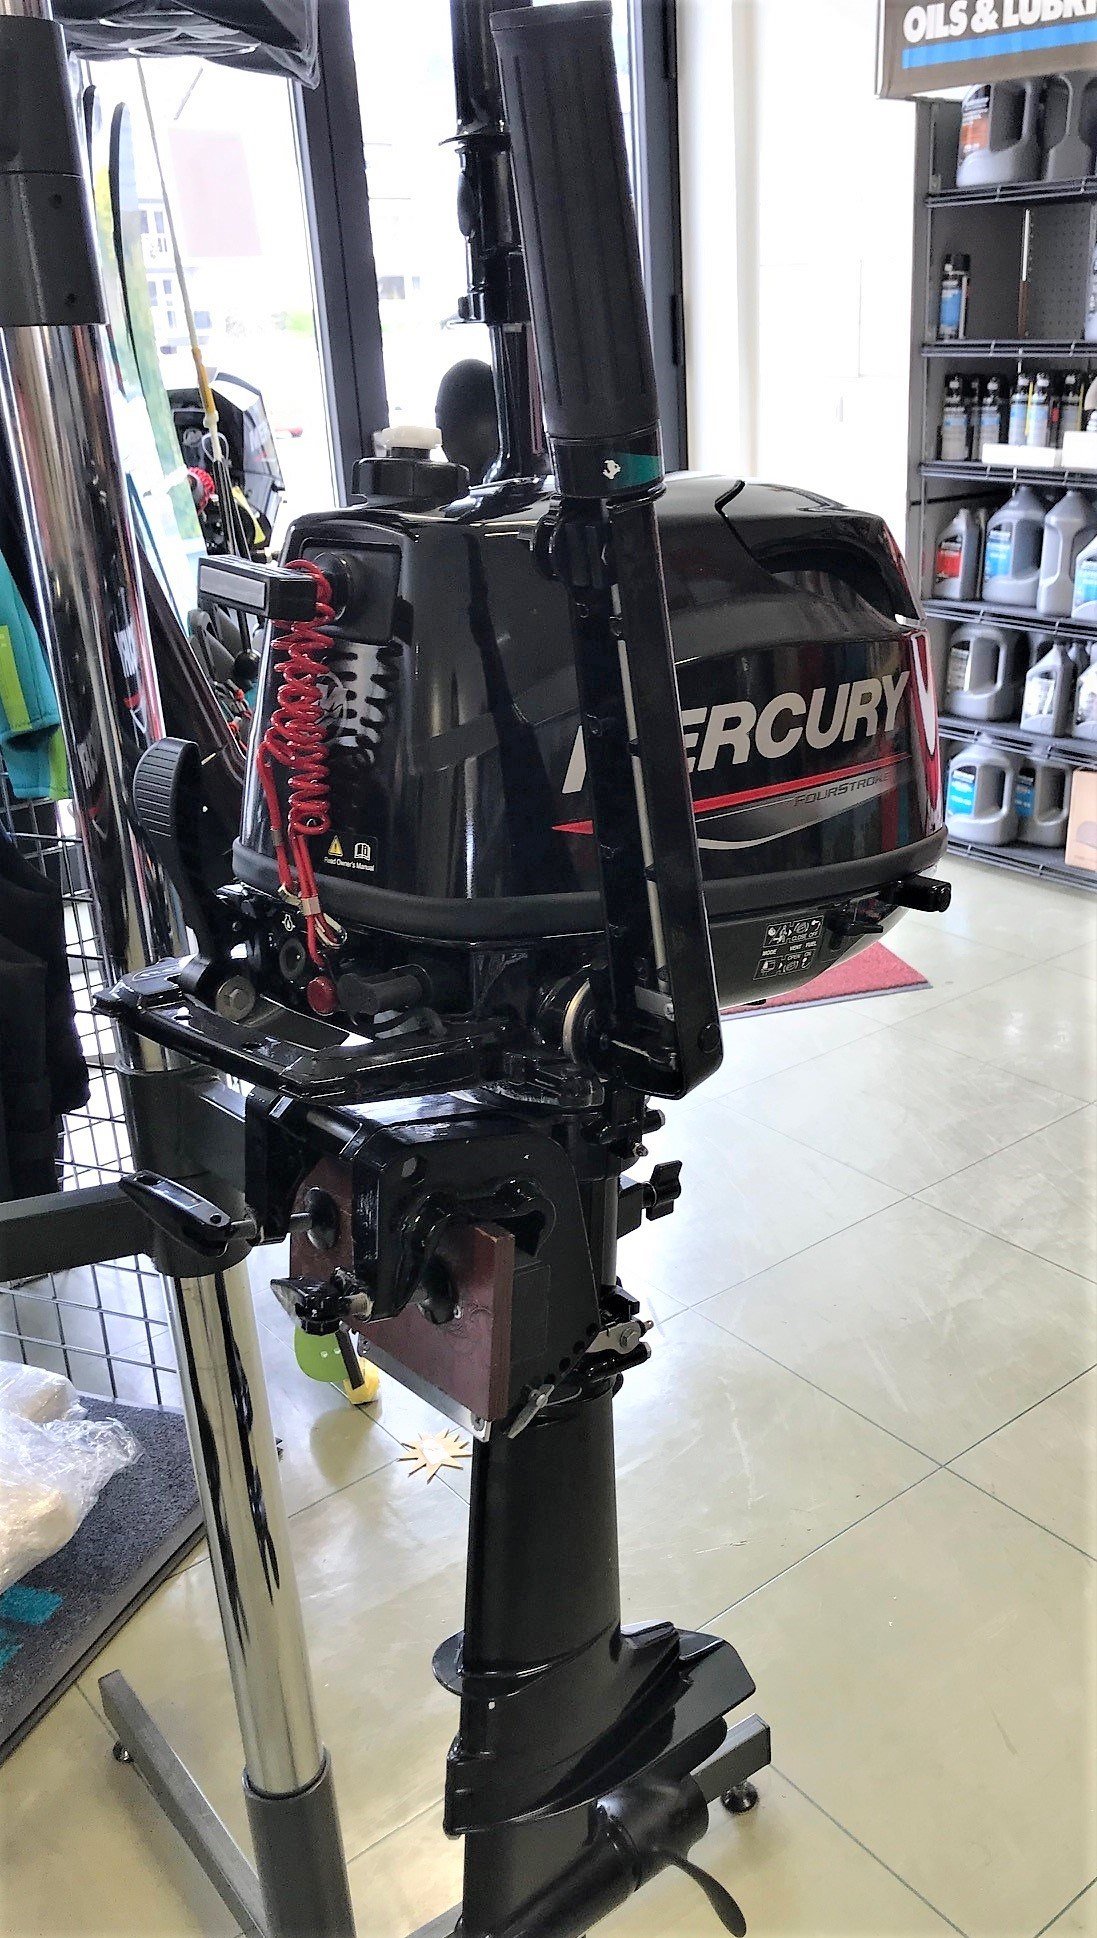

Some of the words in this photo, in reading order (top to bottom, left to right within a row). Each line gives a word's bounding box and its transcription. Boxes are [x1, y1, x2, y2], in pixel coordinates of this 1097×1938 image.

[903, 0, 968, 43] OILS
[971, 0, 999, 33] &
[562, 671, 910, 794] ERCURY
[794, 771, 889, 806] FOURSTROKE
[356, 862, 375, 872] Manual
